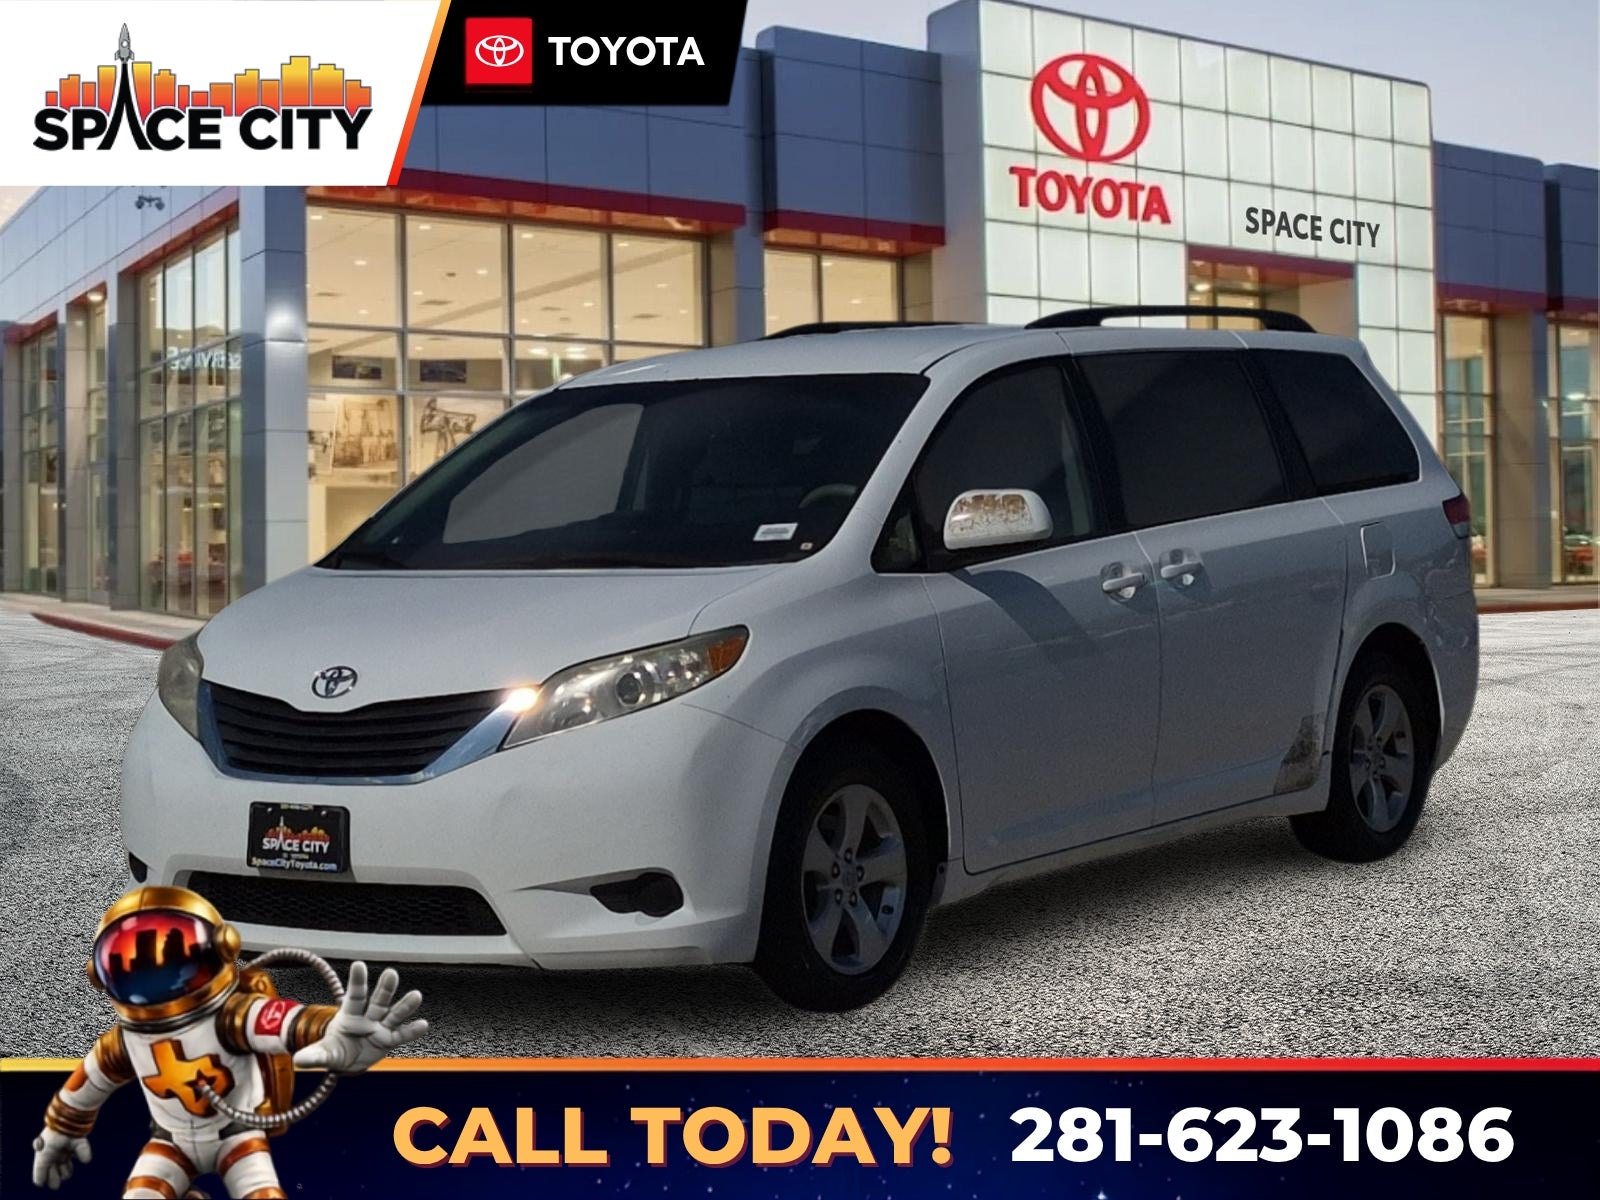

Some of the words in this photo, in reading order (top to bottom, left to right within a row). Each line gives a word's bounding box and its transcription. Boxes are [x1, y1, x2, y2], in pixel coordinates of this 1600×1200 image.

[1009, 166, 1171, 224] TOYOTA
[1245, 206, 1322, 241] SPACE
[1329, 218, 1380, 248] CITY
[262, 836, 300, 852] SPACE
[302, 839, 330, 854] CITY
